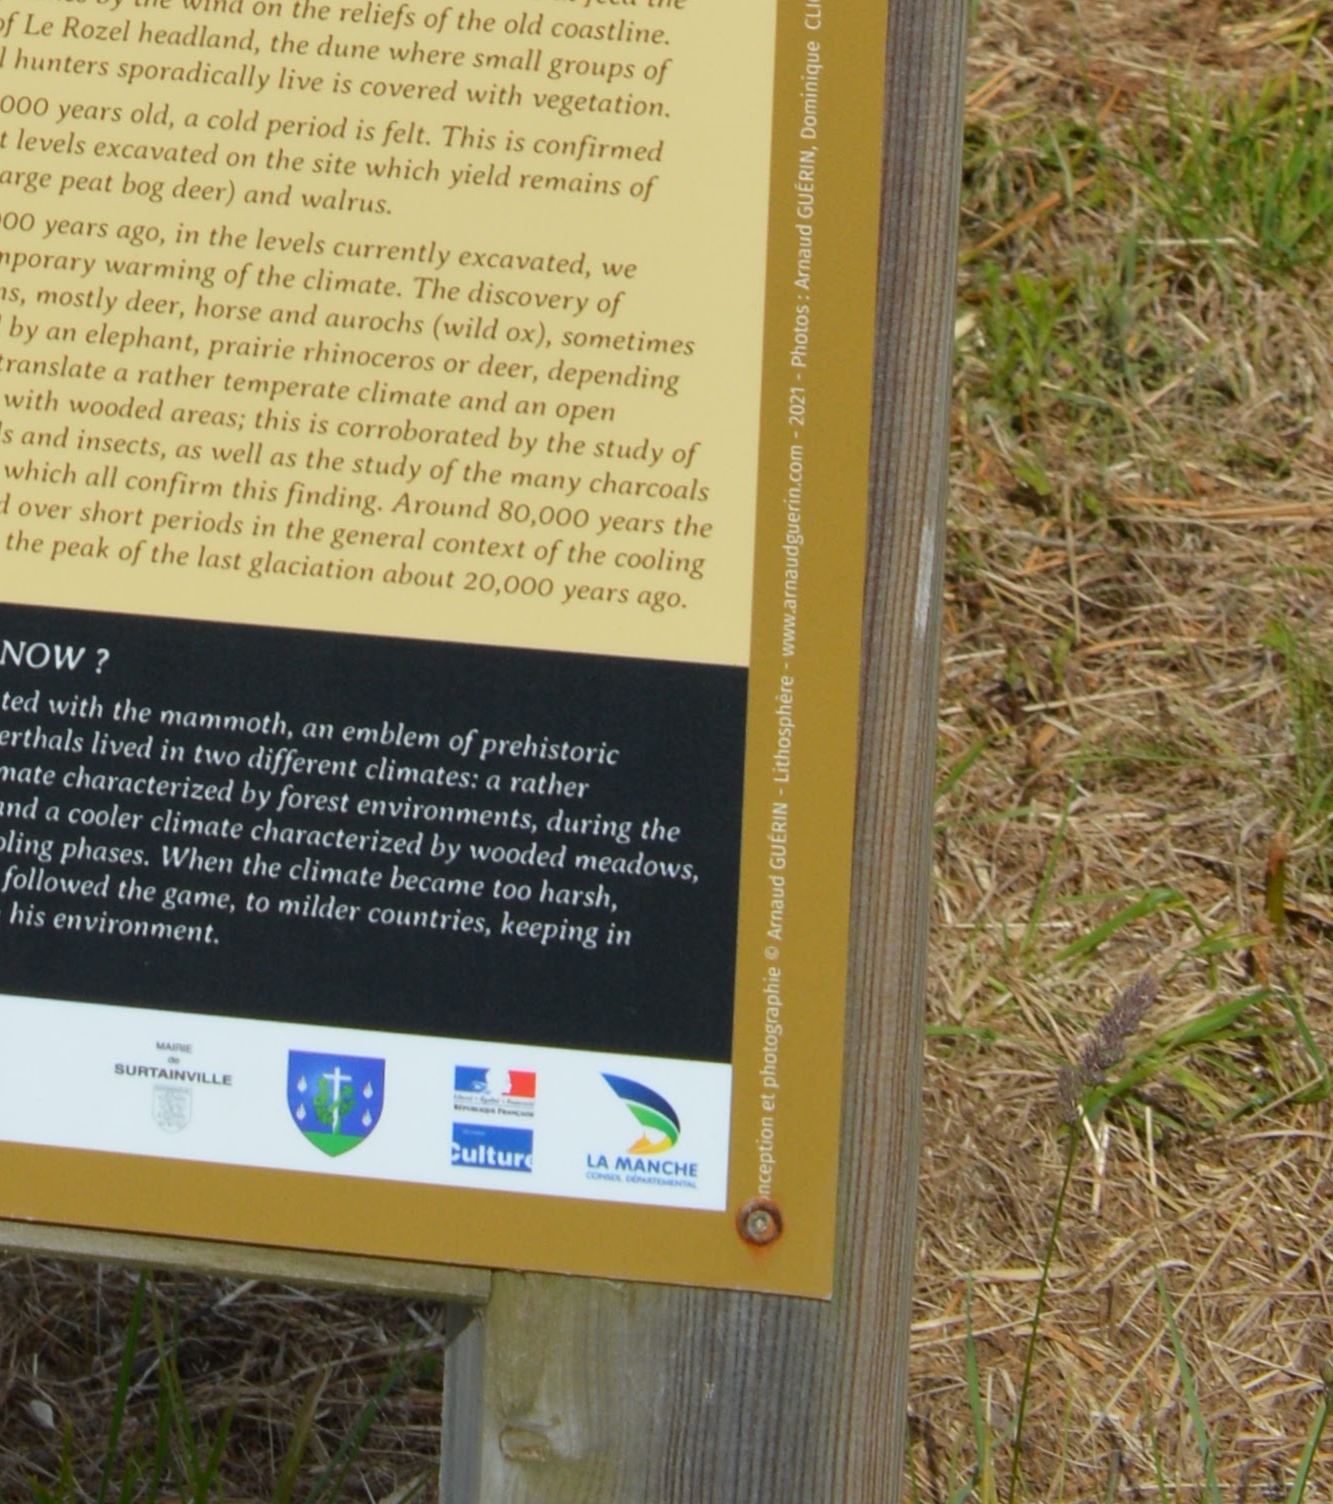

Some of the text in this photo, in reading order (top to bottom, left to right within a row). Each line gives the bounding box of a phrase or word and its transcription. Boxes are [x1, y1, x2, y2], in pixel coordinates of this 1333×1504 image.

[800, 41, 823, 139] Dominique
[794, 146, 818, 219] GUÉRIN,
[794, 224, 813, 290] Arnaud
[790, 305, 809, 367] Photos
[789, 387, 805, 426] 2021
[782, 445, 804, 656] www.arnaudguerin.com
[96, 648, 110, 674] ?
[772, 676, 795, 783] Lithosphère
[768, 802, 788, 870] GUÉRIN
[10, 901, 45, 927] his
[53, 911, 219, 944] environment.
[767, 875, 785, 940] Arnaud
[156, 1041, 193, 1054] MAIRIE
[759, 967, 783, 1088] photographie
[114, 1063, 233, 1087] SURTAINVILLE
[761, 1094, 775, 1111] et
[587, 1153, 698, 1178] LA MANCHE
